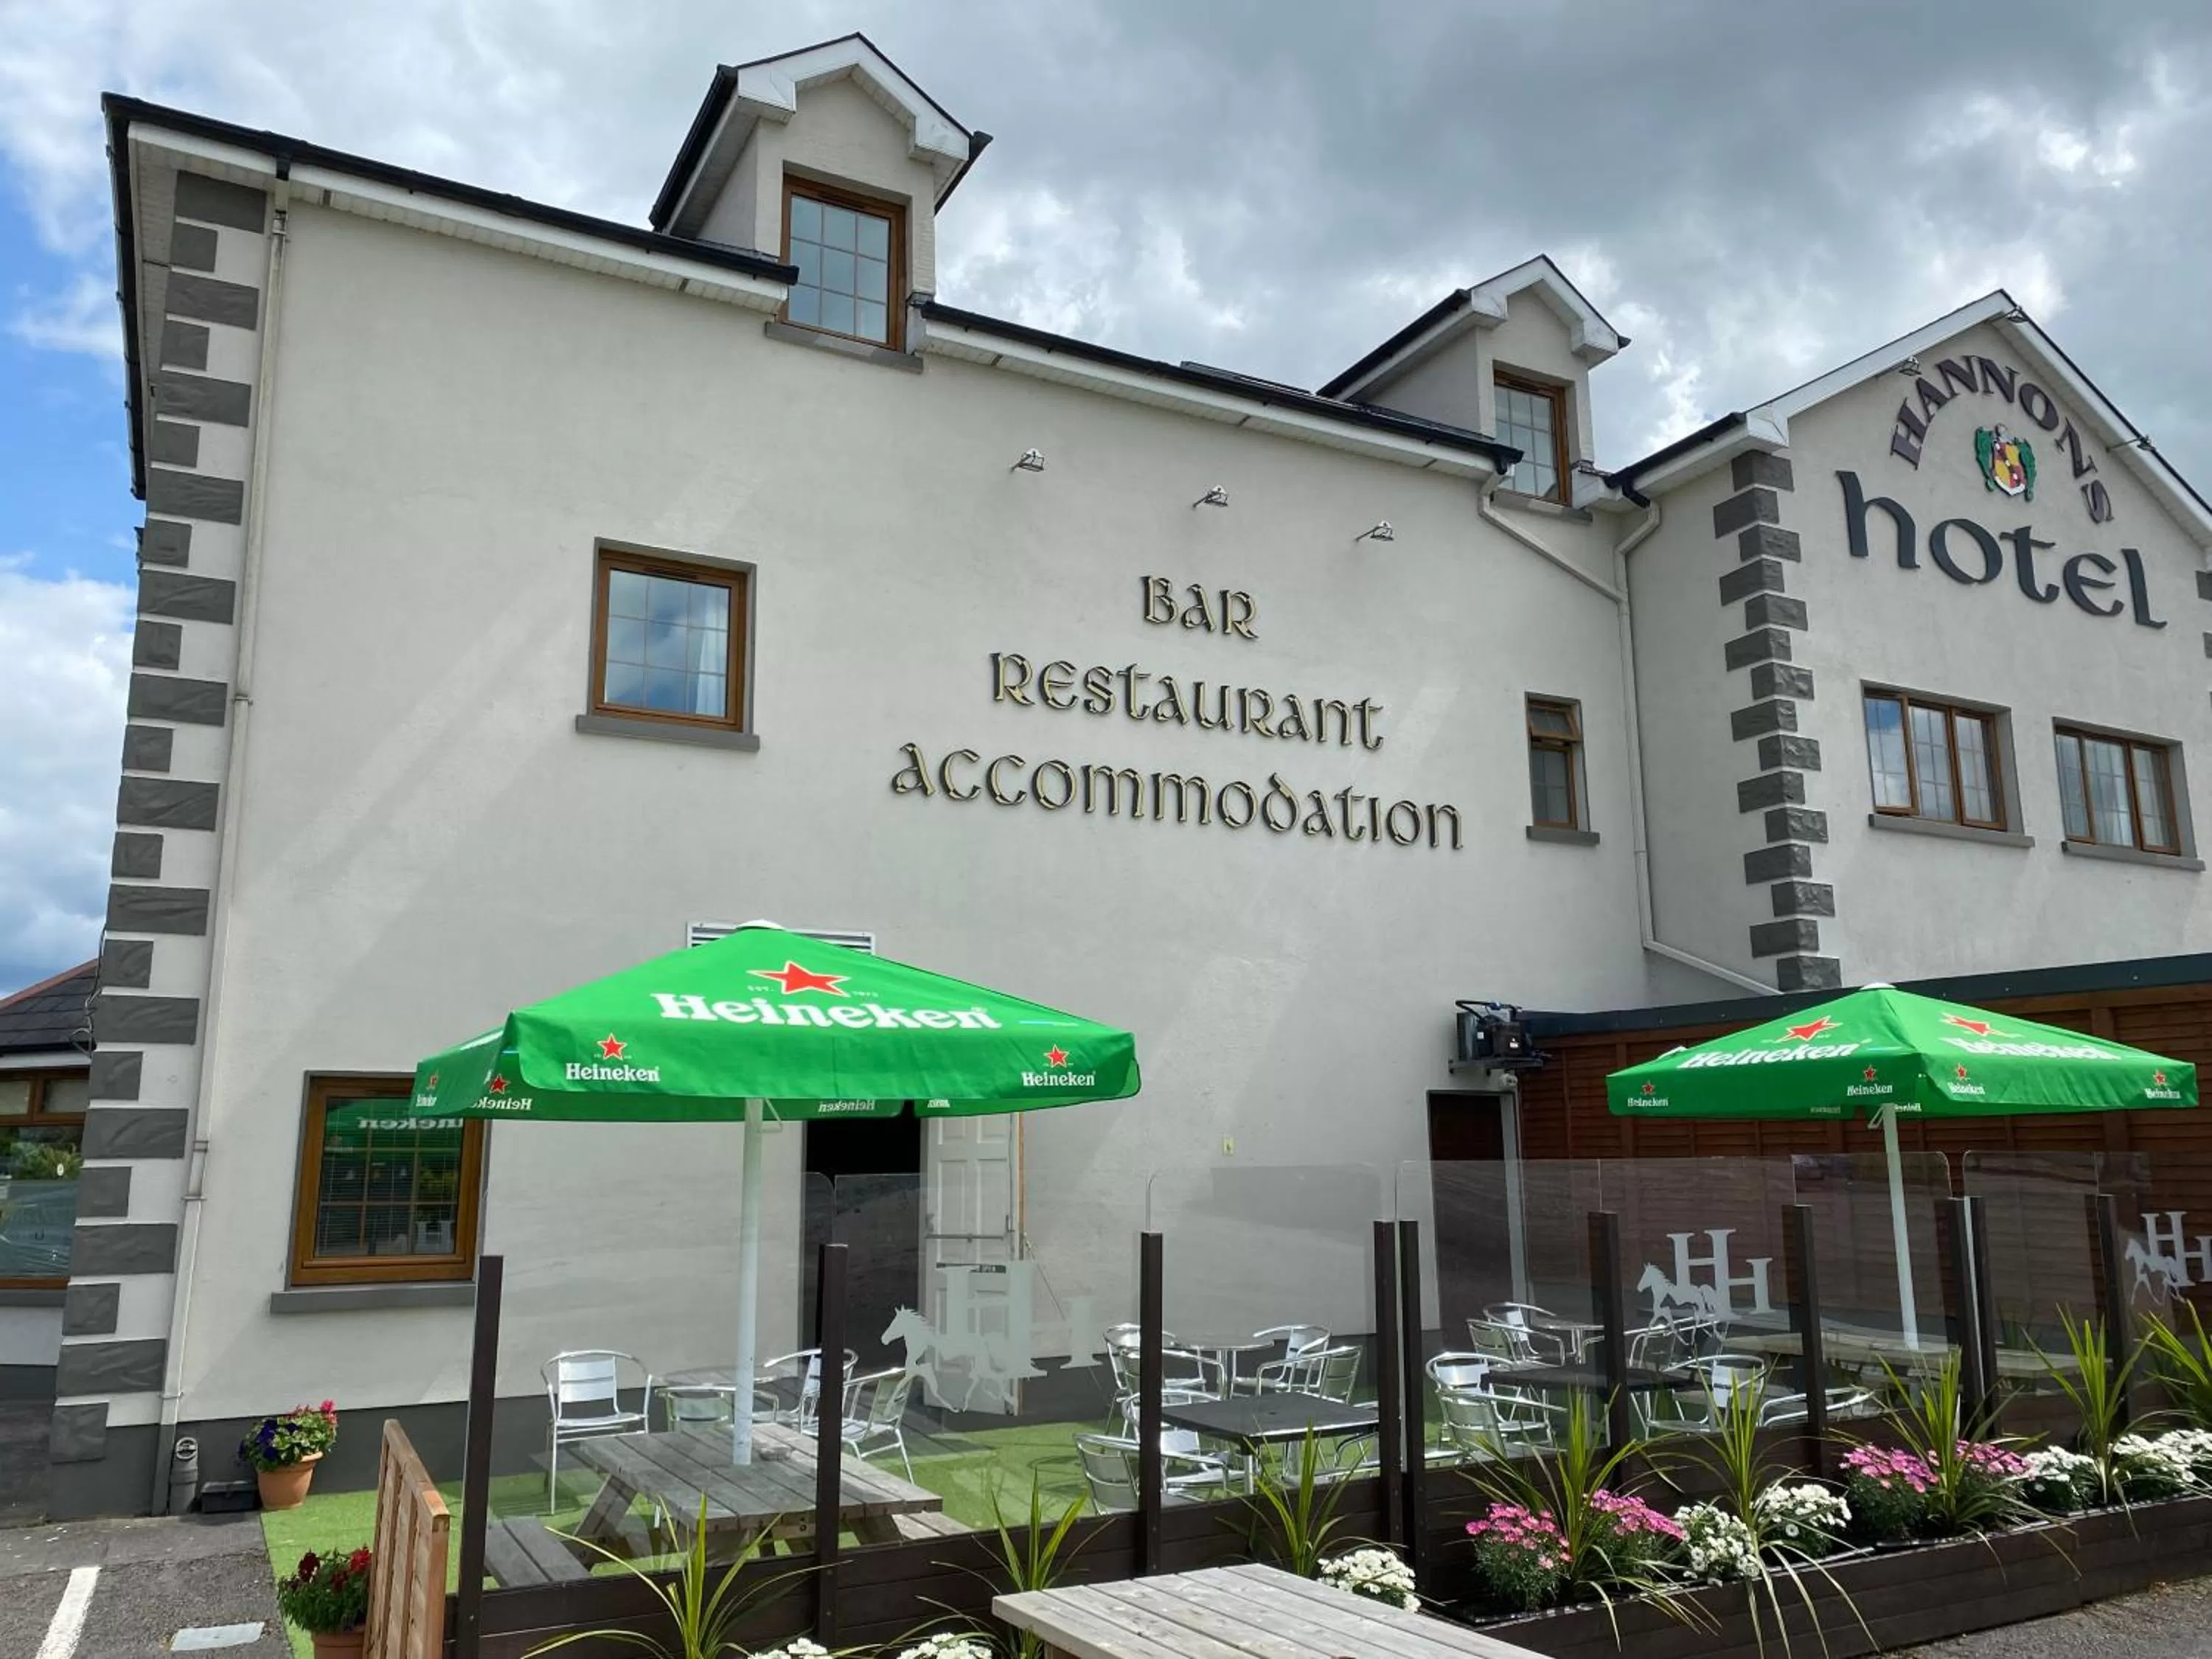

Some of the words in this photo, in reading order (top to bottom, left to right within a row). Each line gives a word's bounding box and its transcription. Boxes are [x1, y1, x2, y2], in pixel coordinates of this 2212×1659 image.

[650, 992, 1003, 1029] Heineken
[1677, 1043, 1860, 1069] Heineken
[566, 1062, 661, 1082] Heineken
[1021, 1071, 1096, 1086] Heineken
[1846, 1084, 1893, 1096] Heineken
[1627, 1096, 1669, 1107] Heineken
